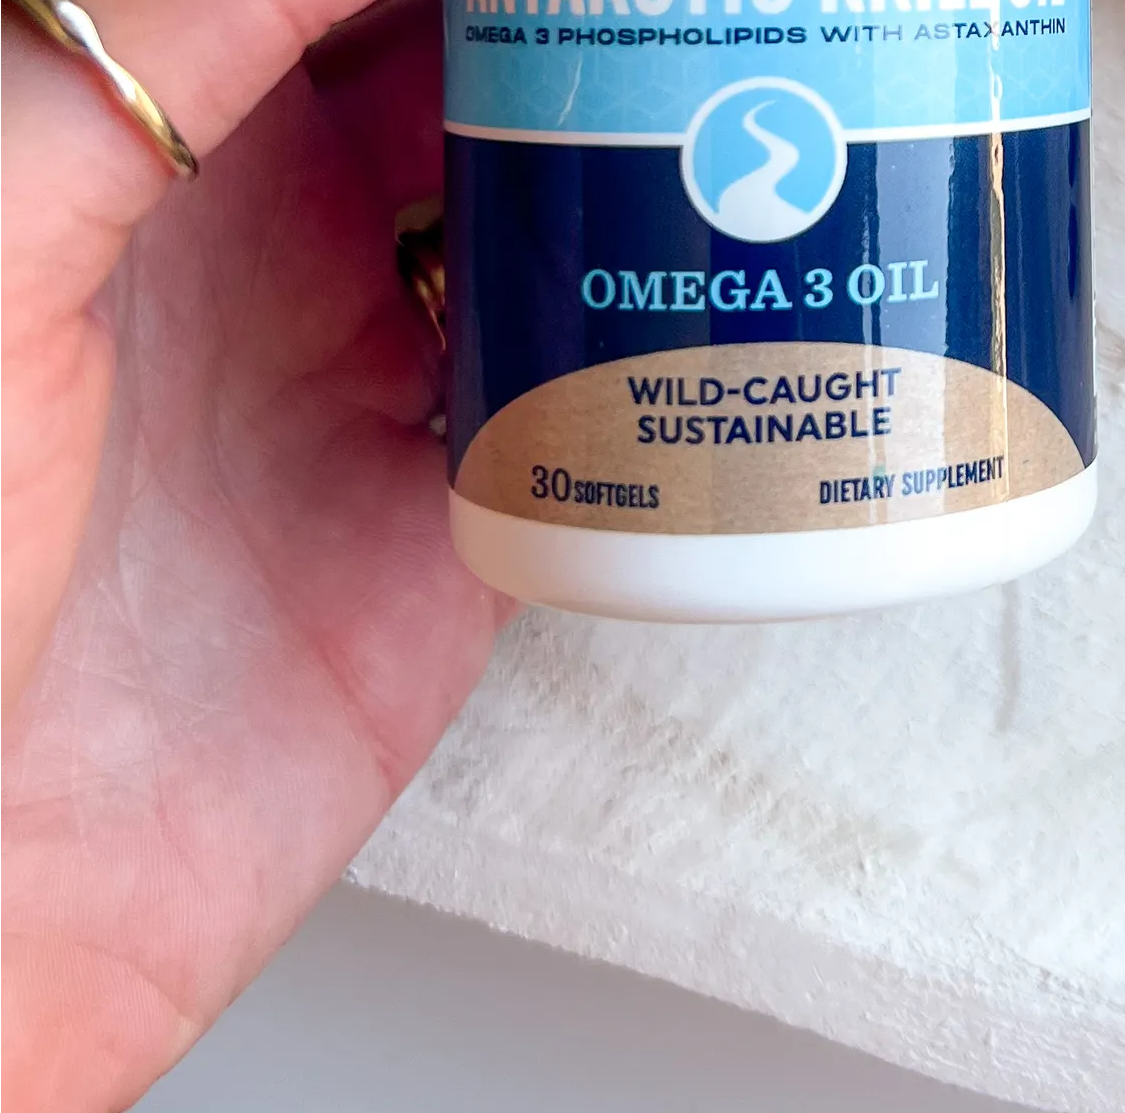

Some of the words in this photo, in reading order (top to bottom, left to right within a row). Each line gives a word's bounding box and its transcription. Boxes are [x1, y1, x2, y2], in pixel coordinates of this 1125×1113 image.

[465, 25, 528, 46] OMEGA
[536, 27, 550, 46] 3
[557, 26, 808, 47] PHOSPHOLIPIDS
[820, 24, 902, 43] WITH
[913, 17, 1067, 41] ASTAXANTHIN
[581, 268, 793, 312] OMEGA
[804, 268, 833, 308] 3
[846, 259, 940, 305] OIL
[627, 367, 902, 407] WILD-CAUGHT
[637, 407, 892, 445] SUSTAINABLE
[574, 482, 660, 510] SOFTGELS
[819, 475, 896, 506] DIETARY
[902, 455, 1006, 497] SUPPLEMENT
